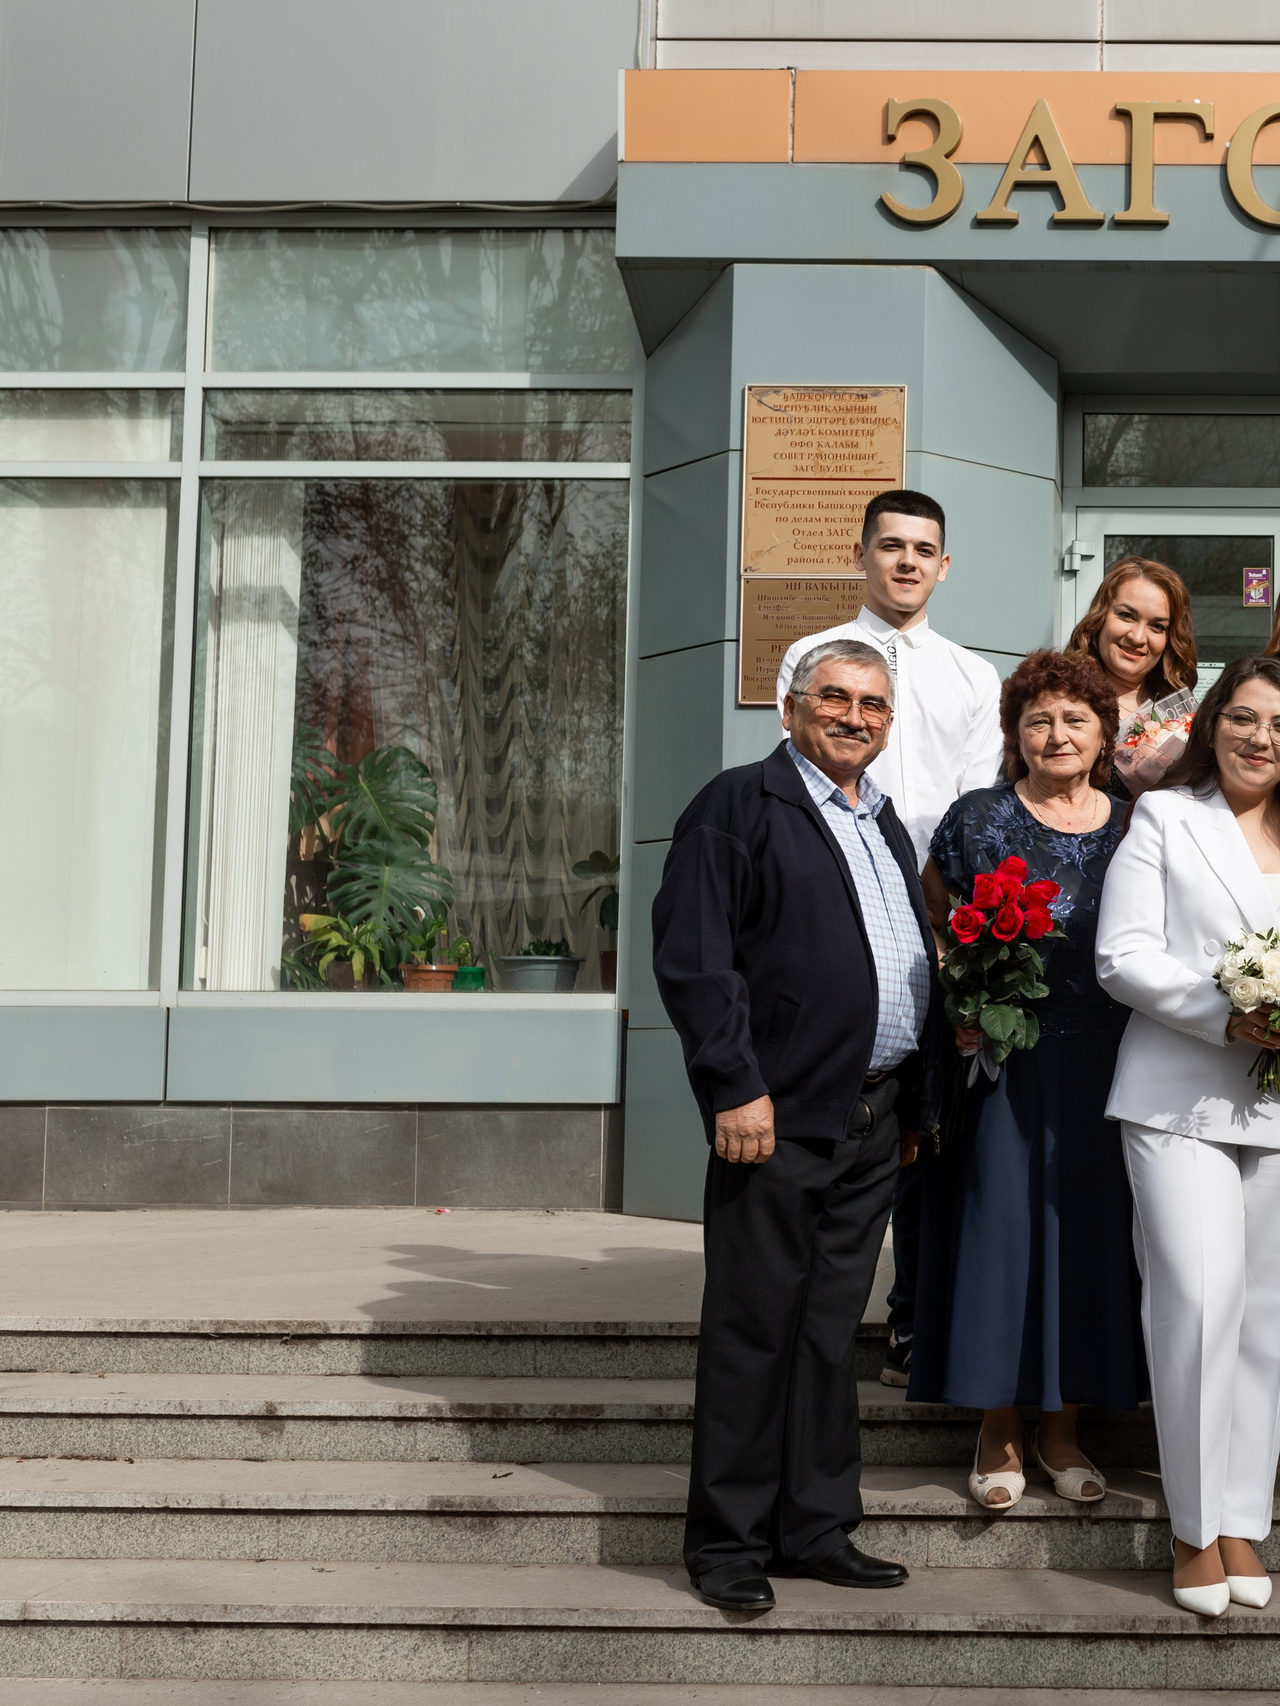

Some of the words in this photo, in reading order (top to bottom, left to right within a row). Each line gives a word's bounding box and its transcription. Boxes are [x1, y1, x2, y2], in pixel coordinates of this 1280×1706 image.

[818, 428, 875, 437] КОМИТЕТЫ
[773, 452, 805, 461] СОВЕТ
[793, 464, 817, 473] ЗАГС
[755, 486, 846, 498] Государственный
[754, 500, 815, 512] Республики
[818, 501, 868, 512] Башкорто
[791, 516, 822, 524] делам
[824, 516, 864, 524] юстици
[792, 528, 824, 537] Отдел
[826, 528, 853, 537] ЗАГС
[793, 541, 852, 551] Советского
[787, 556, 824, 566] района
[837, 555, 855, 567] Уф
